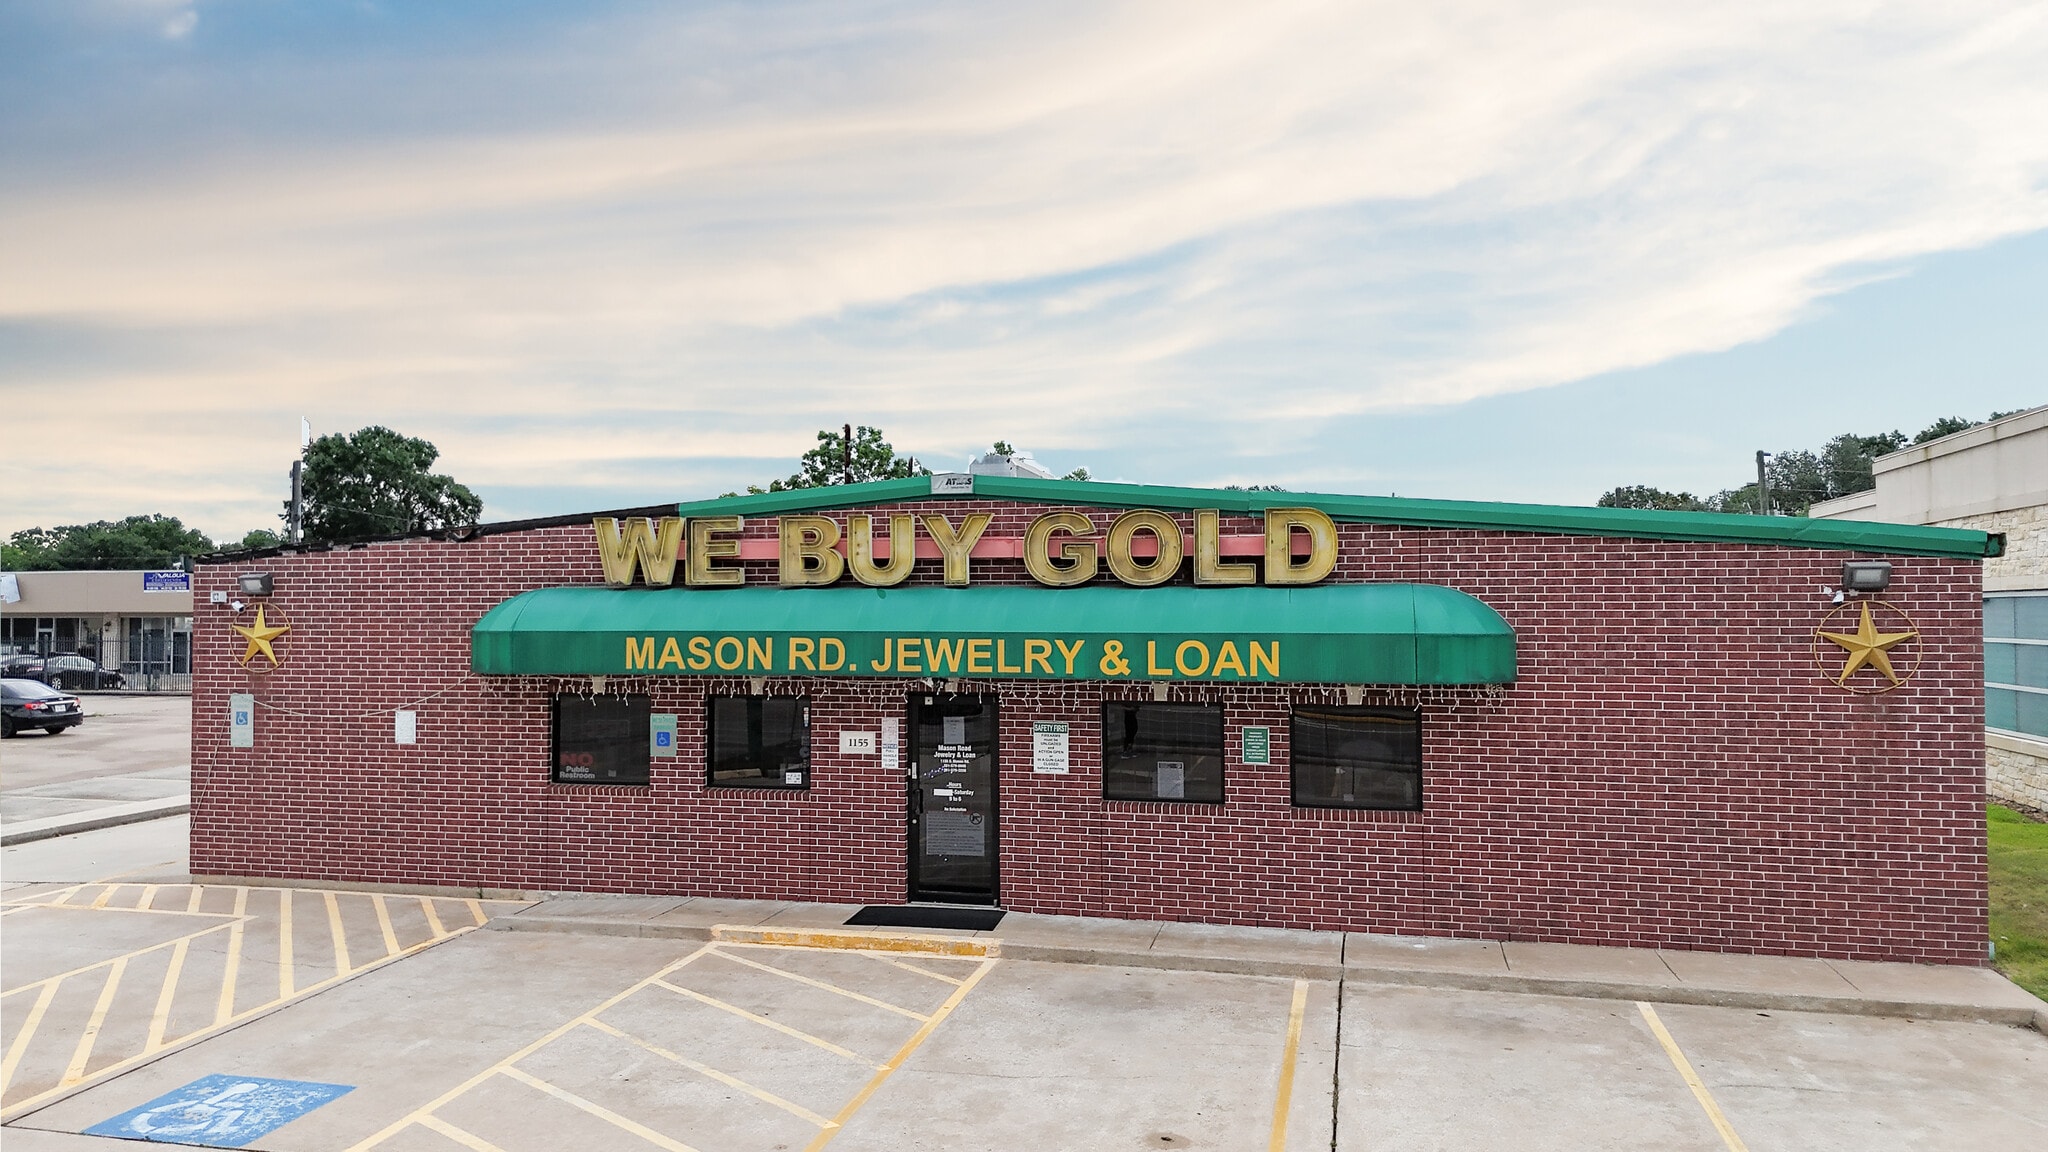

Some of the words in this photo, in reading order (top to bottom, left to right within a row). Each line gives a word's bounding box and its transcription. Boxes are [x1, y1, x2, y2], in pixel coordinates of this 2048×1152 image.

[593, 515, 746, 586] WE
[779, 513, 994, 587] BUY
[1023, 507, 1339, 587] GOLD
[625, 637, 772, 670] MASON
[788, 637, 857, 671] RD.
[871, 638, 1085, 672] JEWELRY
[1100, 639, 1132, 676] &
[1147, 640, 1280, 677] LOAN
[1034, 724, 1053, 732] SAFETY
[848, 737, 869, 747] 1155
[560, 753, 594, 766] NO
